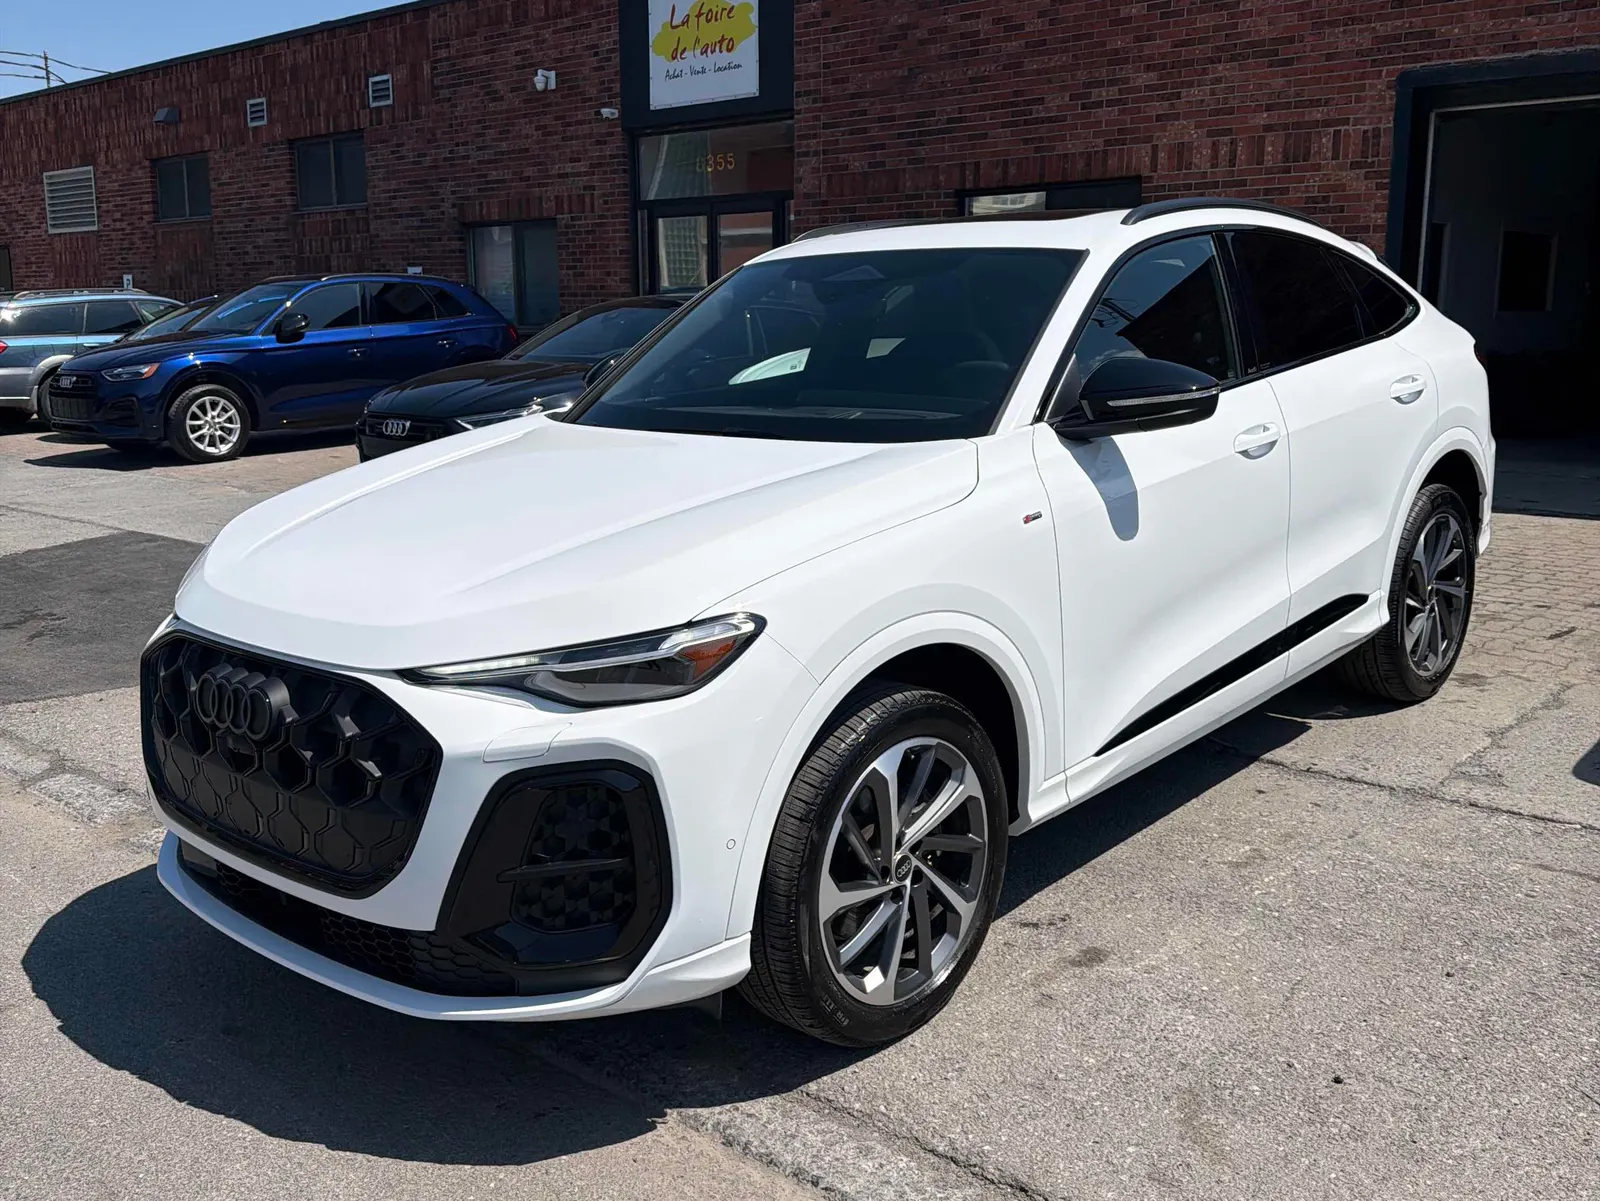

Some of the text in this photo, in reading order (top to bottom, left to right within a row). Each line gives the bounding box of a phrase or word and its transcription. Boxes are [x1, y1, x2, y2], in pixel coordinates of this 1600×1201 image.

[669, 2, 736, 31] La foire
[671, 34, 735, 62] de l'auto
[664, 69, 683, 82] Achat
[689, 65, 707, 77] Vente
[713, 61, 743, 74] Location
